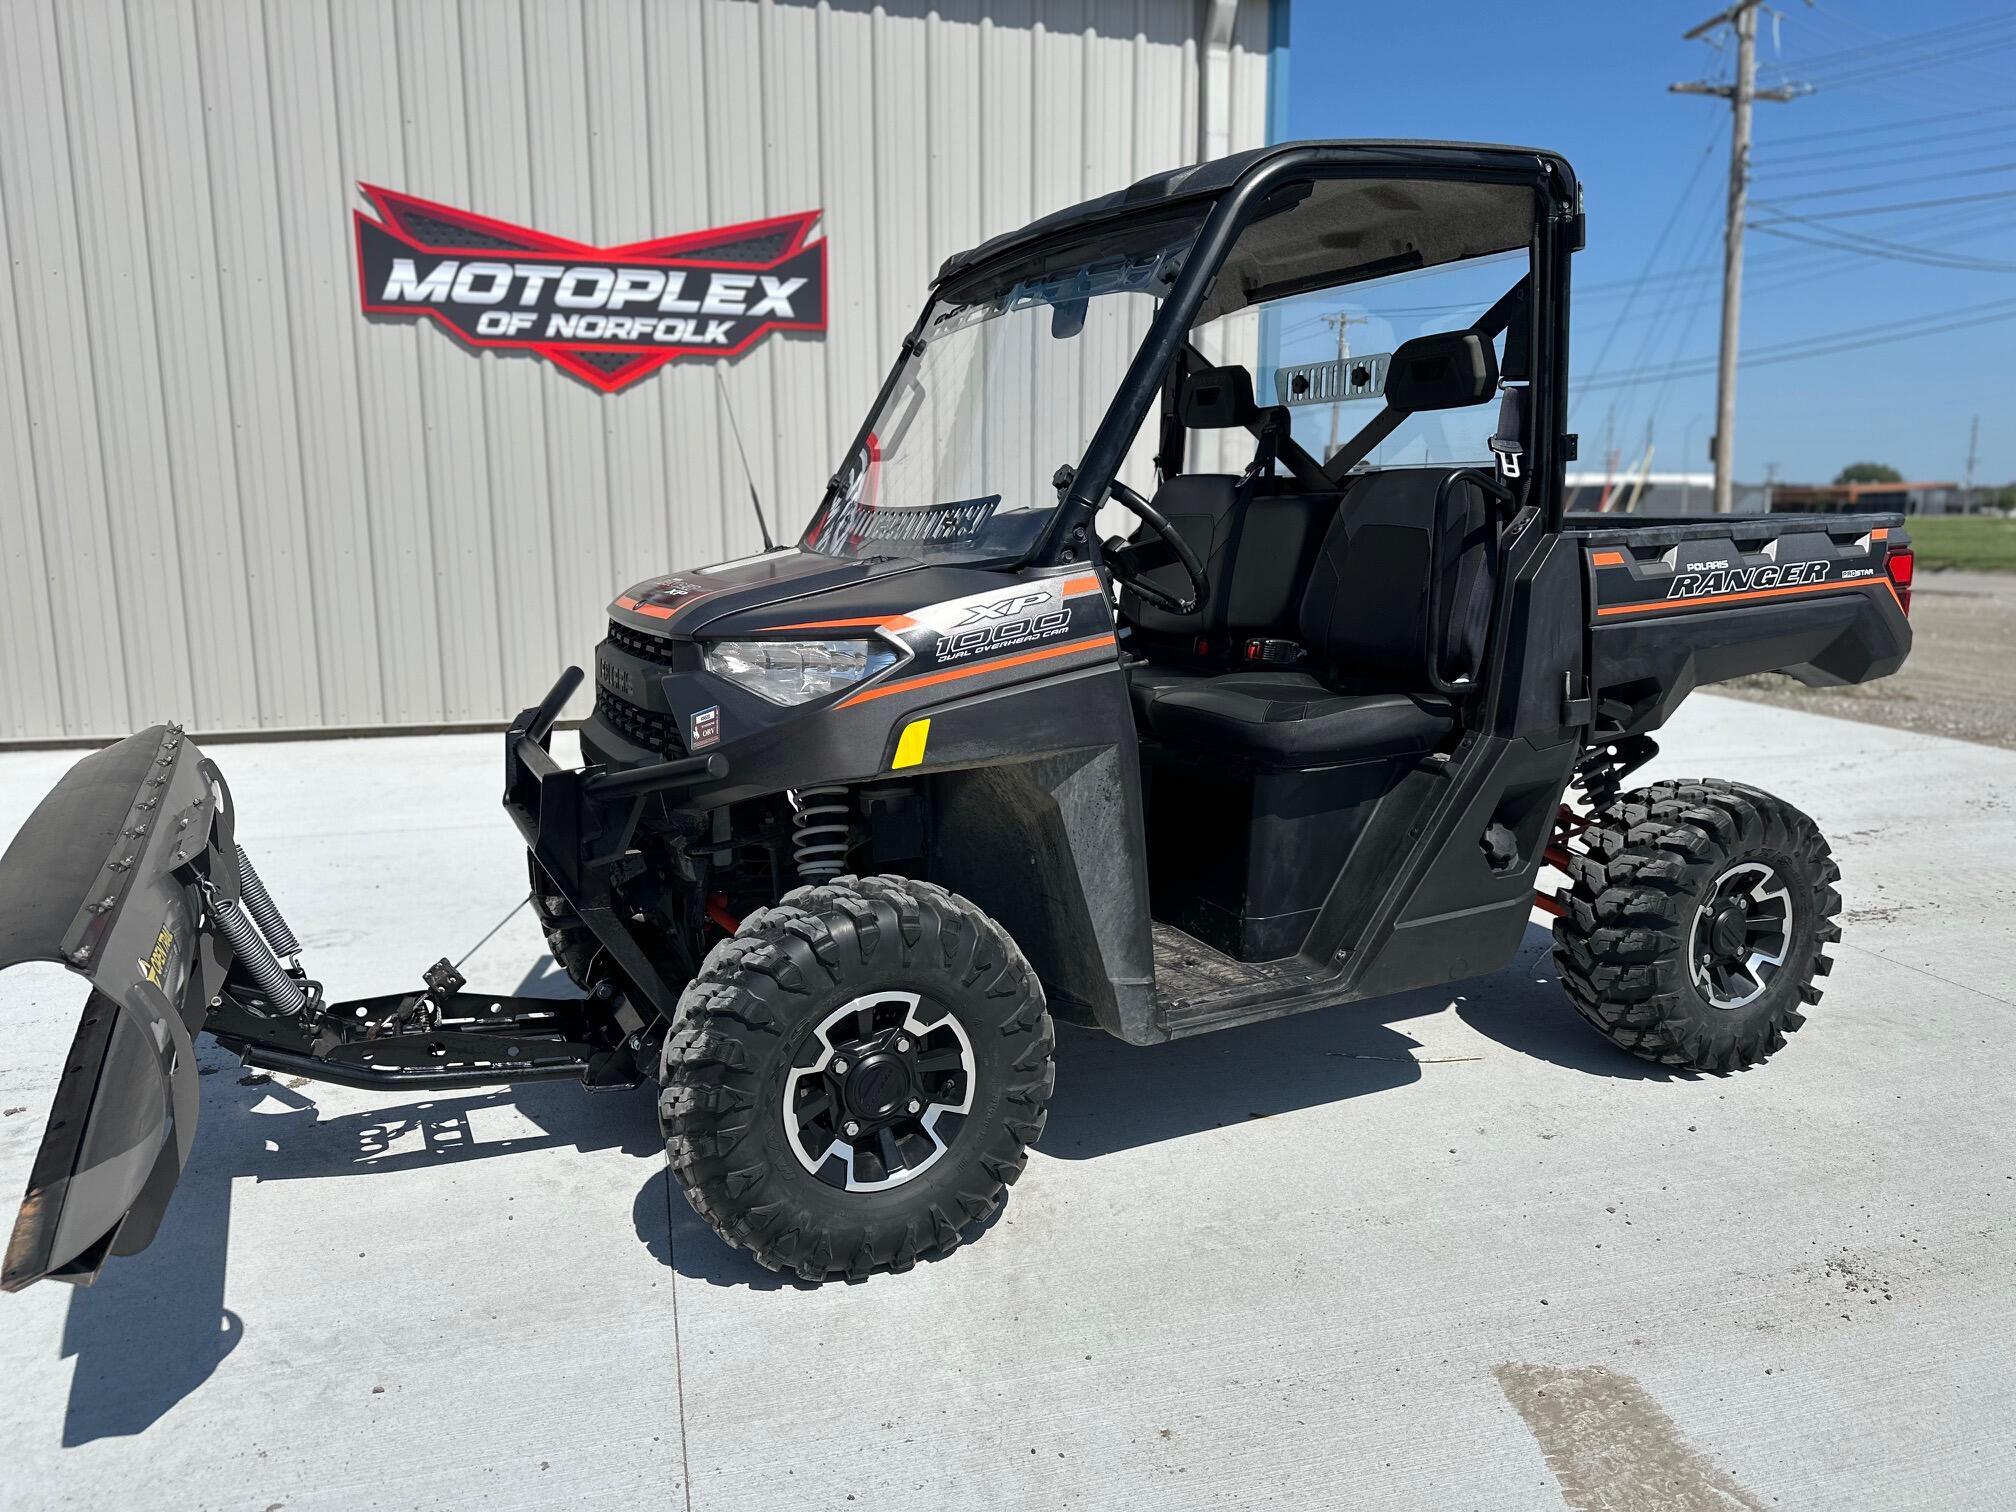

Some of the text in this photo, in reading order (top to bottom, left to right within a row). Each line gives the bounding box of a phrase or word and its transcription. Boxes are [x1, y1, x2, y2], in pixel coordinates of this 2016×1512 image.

[382, 258, 808, 318] MOTOPLEX
[476, 311, 736, 344] OF NORFOLK
[1667, 560, 1830, 599] RANGER
[1687, 560, 1728, 572] POLARIS
[950, 591, 1053, 629] XP
[935, 608, 1072, 656] 1000
[937, 626, 1069, 662] DUAL OVERHEAD CAM
